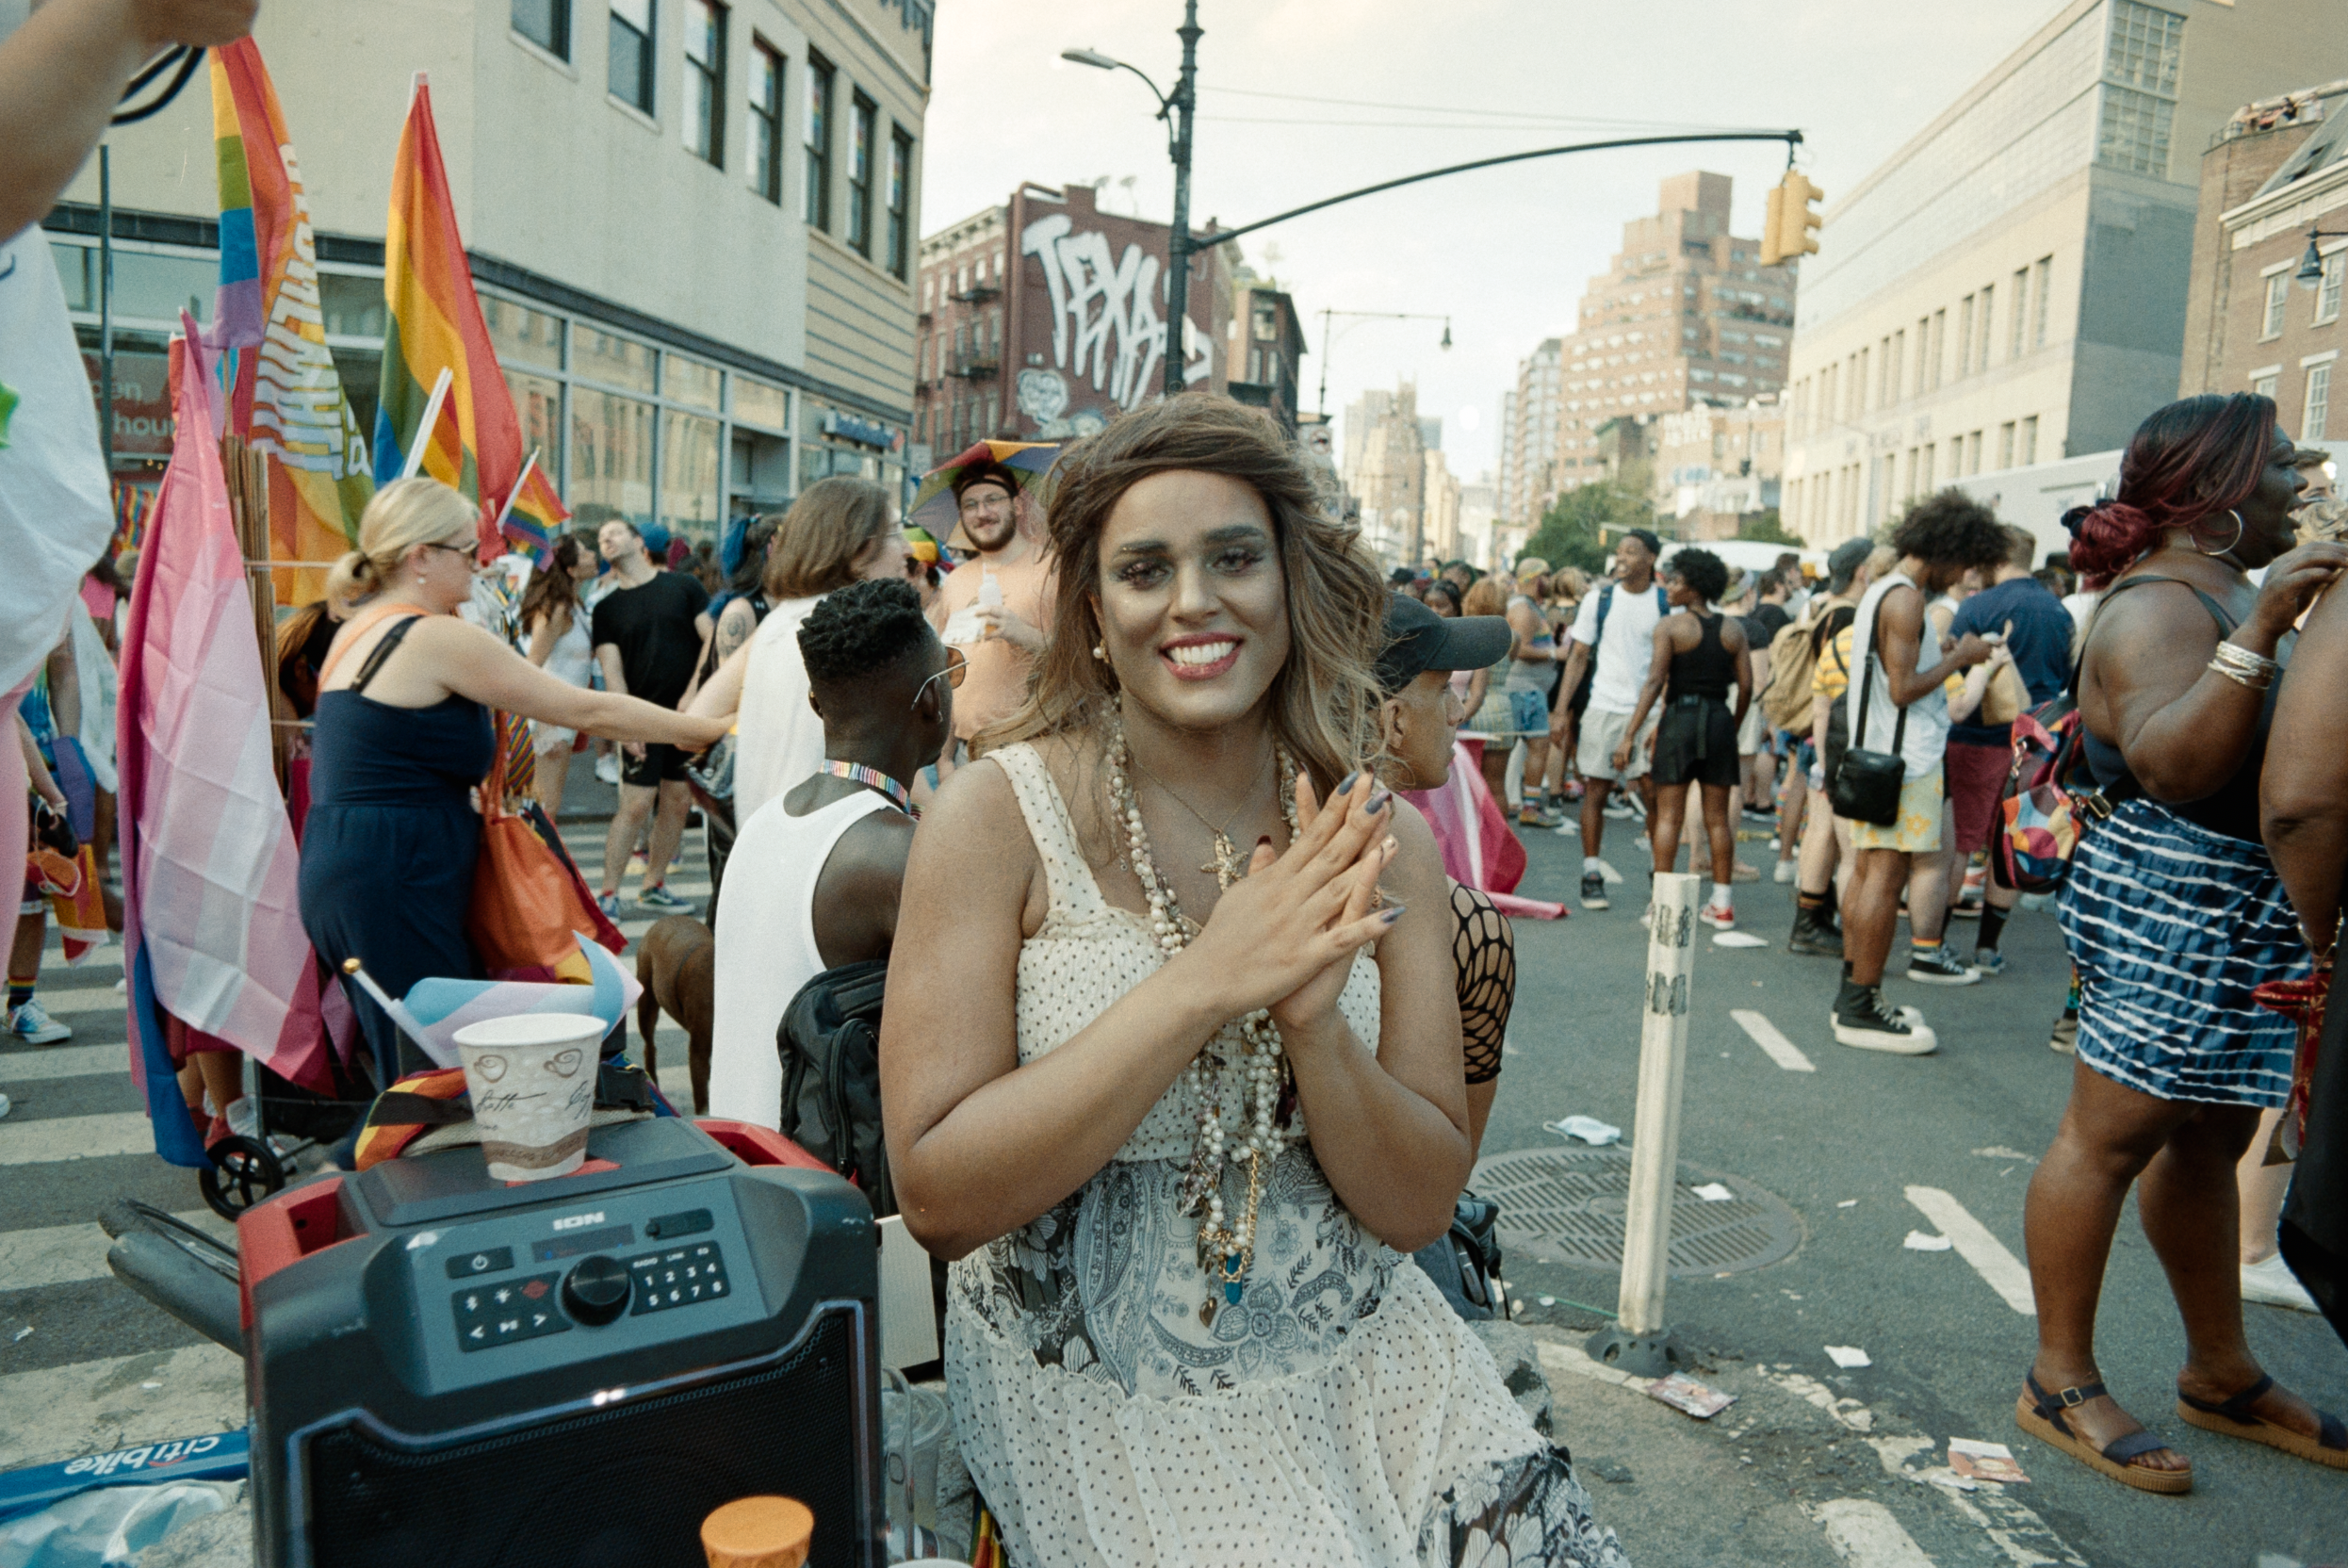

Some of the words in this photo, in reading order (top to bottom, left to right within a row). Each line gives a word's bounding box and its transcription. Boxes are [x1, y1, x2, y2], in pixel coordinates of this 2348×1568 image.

[553, 1211, 605, 1231] ION
[644, 1275, 654, 1287] 1
[665, 1270, 676, 1282] 2
[687, 1266, 696, 1278] 3
[707, 1263, 716, 1273] 4
[648, 1294, 659, 1306] 5
[670, 1289, 680, 1301] 6
[691, 1284, 701, 1298] 7
[712, 1281, 723, 1293] 8
